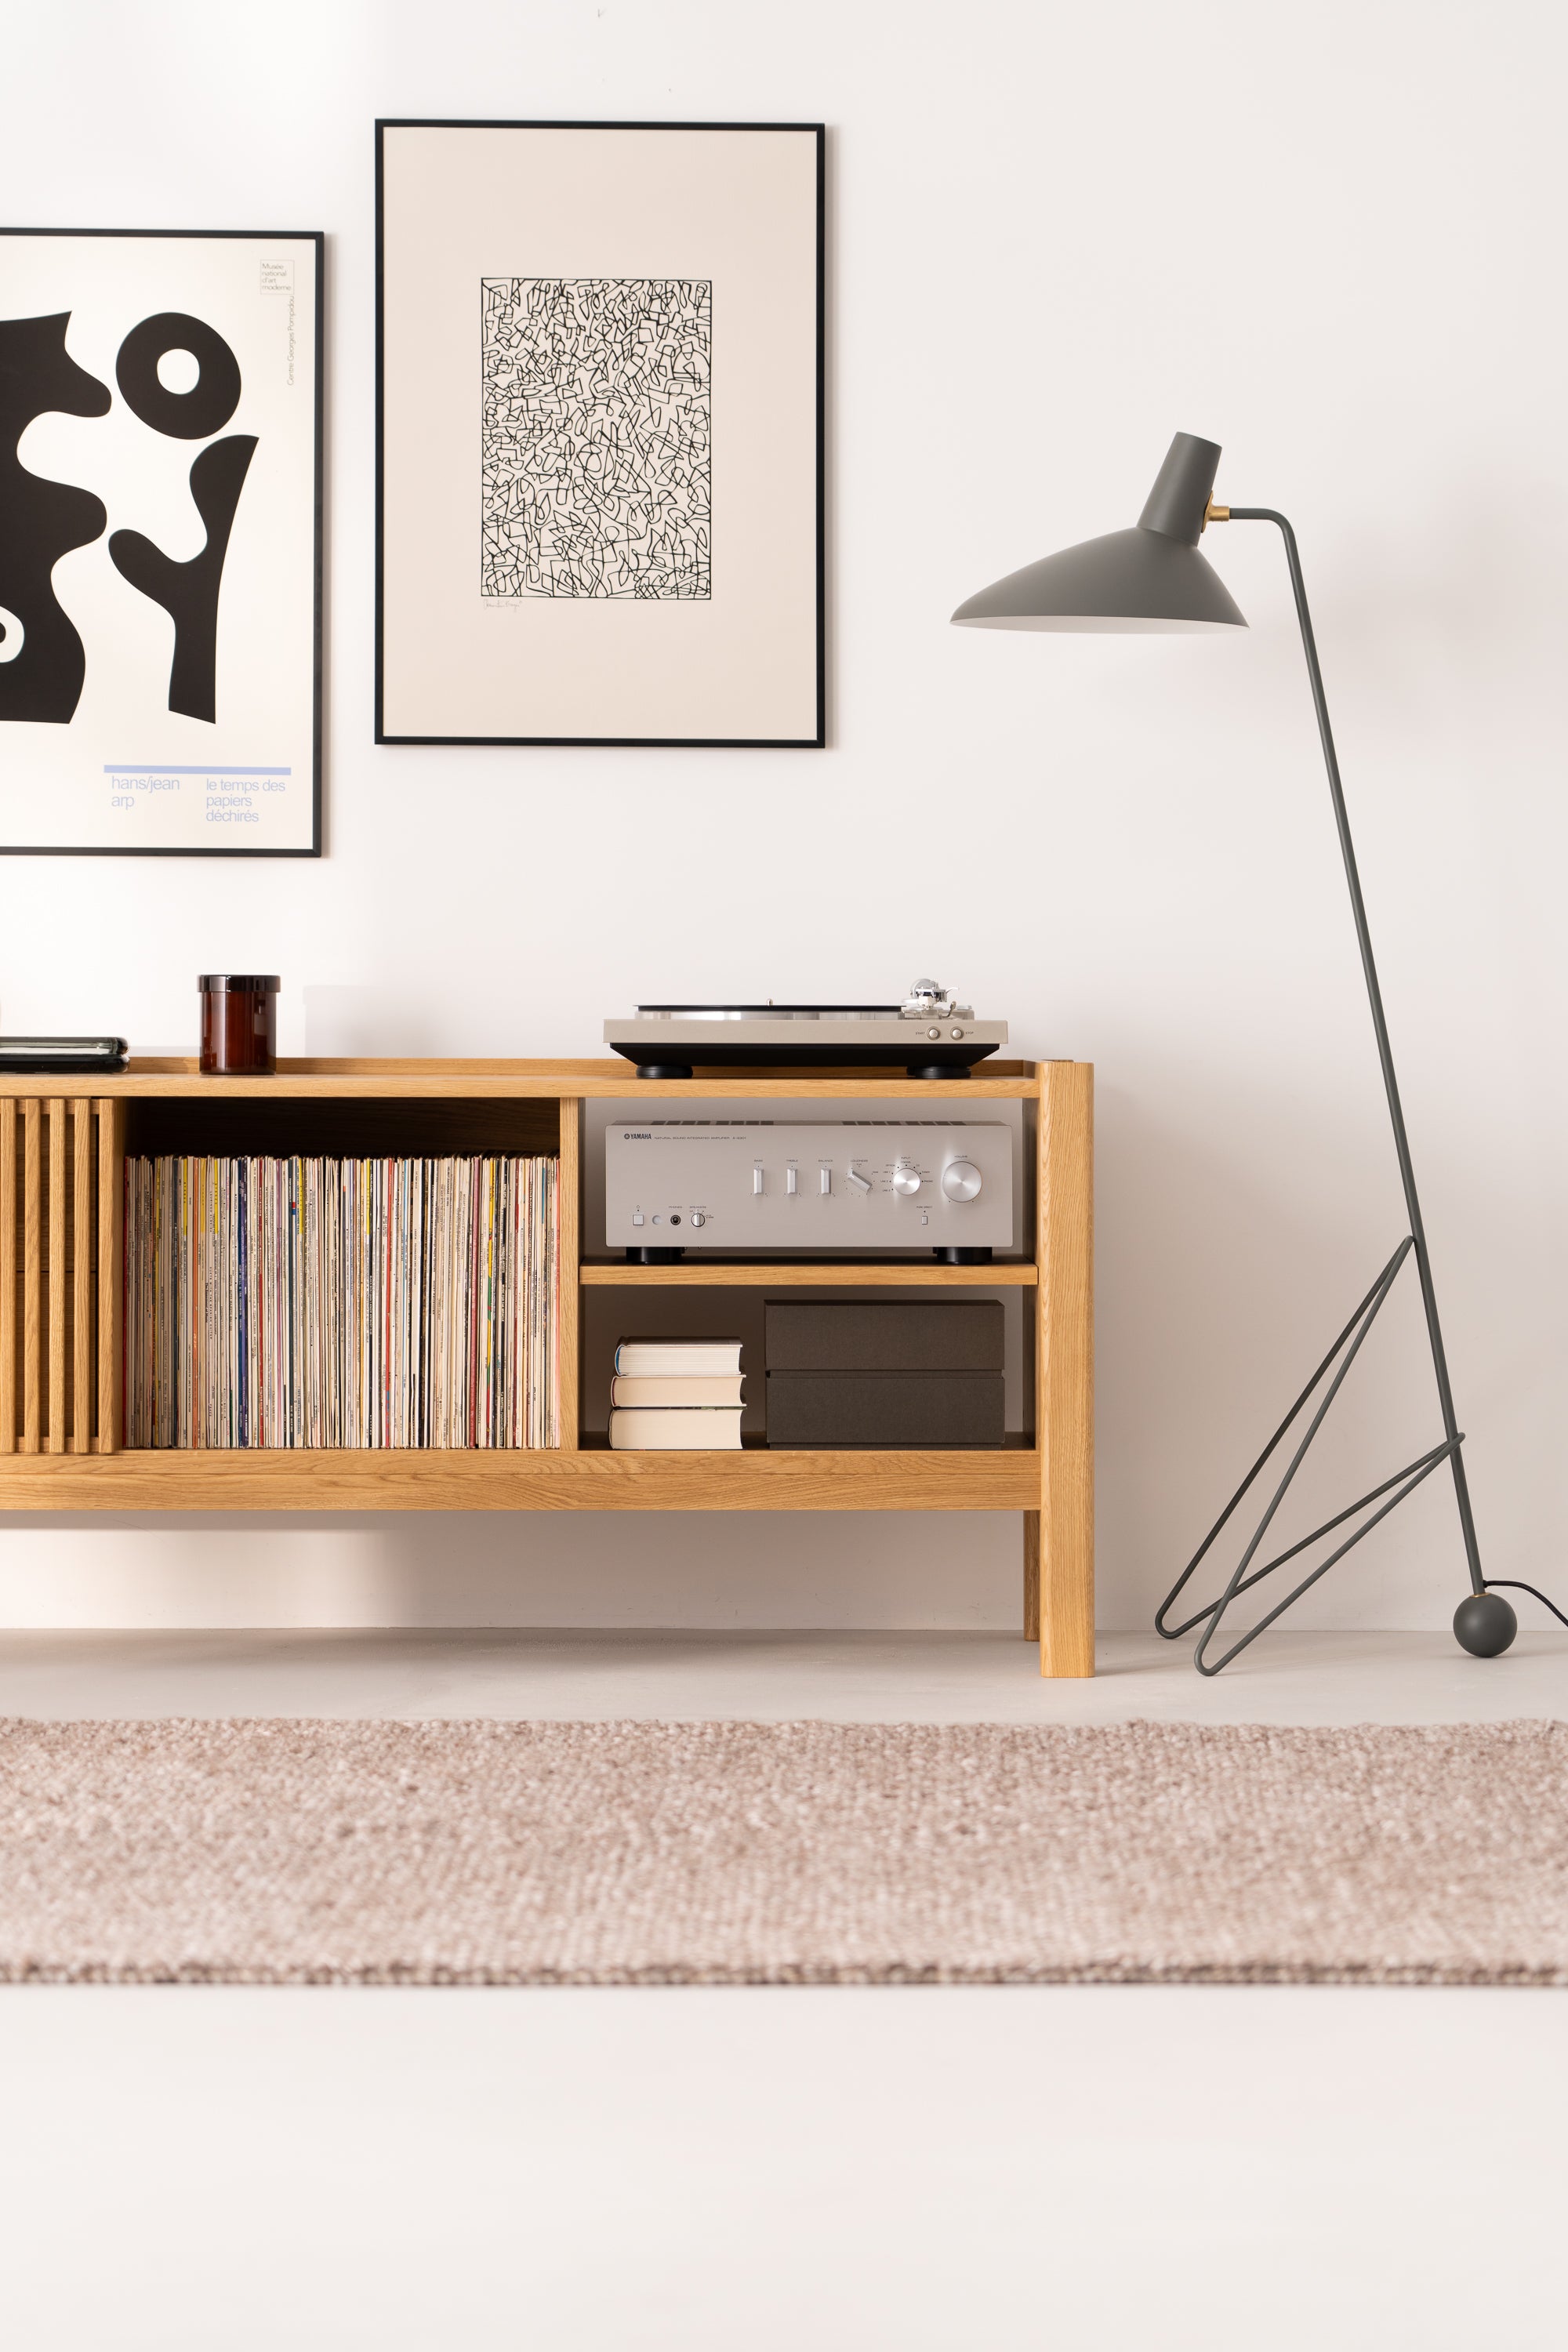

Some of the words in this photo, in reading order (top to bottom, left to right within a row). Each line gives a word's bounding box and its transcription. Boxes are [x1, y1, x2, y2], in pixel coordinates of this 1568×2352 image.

[287, 296, 296, 331] Pompidou
[287, 332, 296, 361] Georges
[111, 776, 180, 793] hans/jean
[206, 779, 217, 791] le
[220, 779, 260, 793] temps
[263, 779, 285, 792] des
[111, 796, 135, 810] arp
[206, 794, 252, 808] papiers
[205, 808, 260, 822] déchirés
